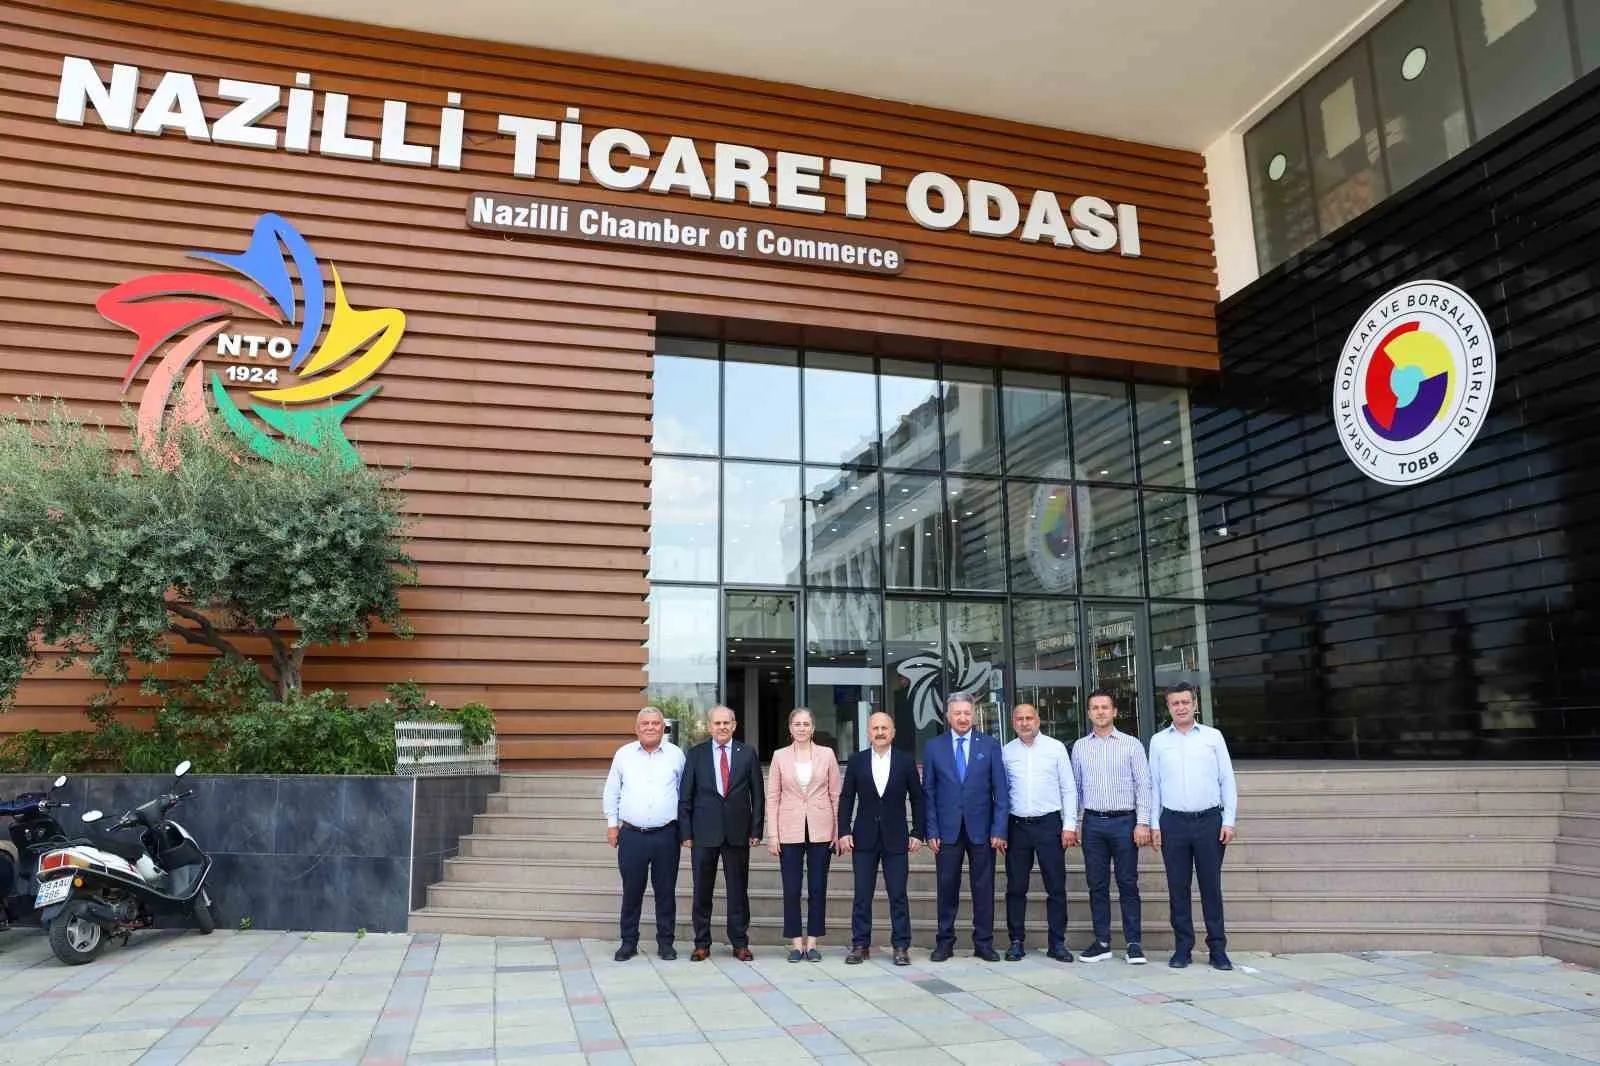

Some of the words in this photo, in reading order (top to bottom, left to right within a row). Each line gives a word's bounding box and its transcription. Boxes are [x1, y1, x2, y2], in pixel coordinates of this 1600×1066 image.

[55, 55, 464, 171] NAZİLLİ
[497, 107, 882, 218] TİCARET
[904, 171, 1142, 257] ODASI
[472, 196, 569, 233] Nazilli
[579, 209, 708, 248] Chamber
[719, 226, 748, 252] of
[756, 229, 900, 270] Commerce
[217, 333, 292, 359] NTO
[1342, 321, 1377, 391] ODALAR
[1380, 301, 1400, 318] VE
[1407, 293, 1480, 350] BORSALAR
[225, 366, 278, 384] 1924
[1398, 451, 1440, 475] TOBB
